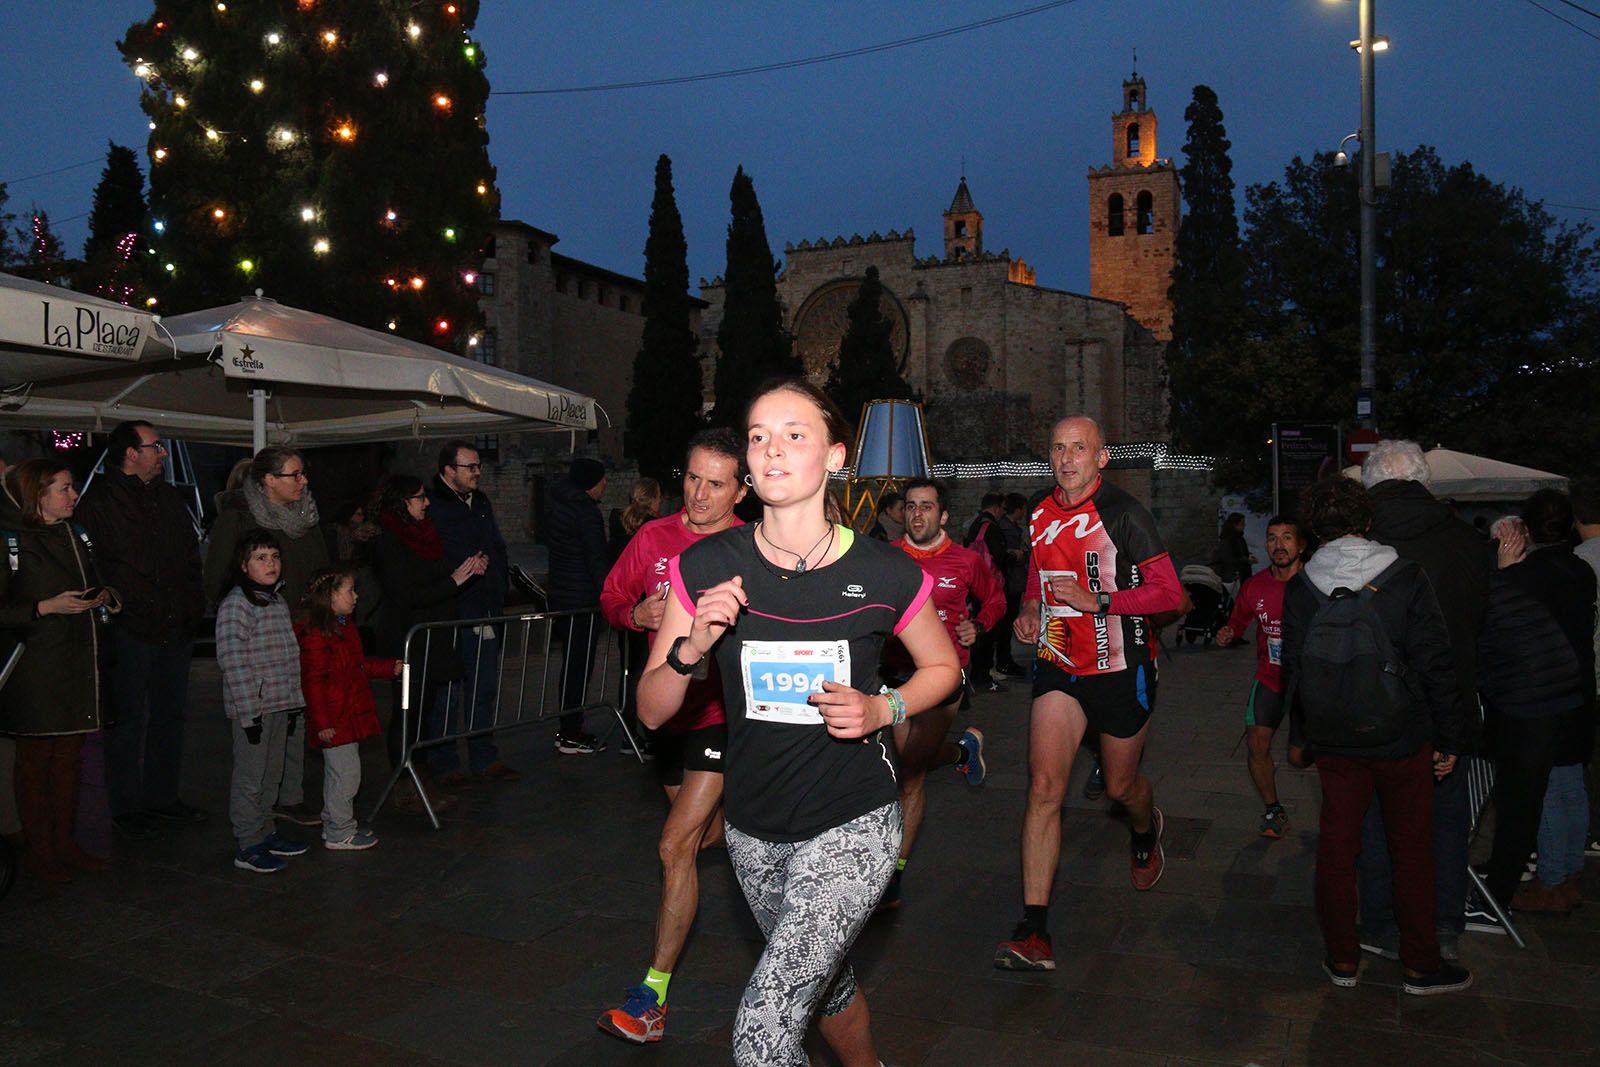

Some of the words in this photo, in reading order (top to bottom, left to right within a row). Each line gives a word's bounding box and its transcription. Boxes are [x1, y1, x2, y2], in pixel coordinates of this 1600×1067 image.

[41, 301, 72, 348] La
[75, 306, 140, 350] Placa
[232, 356, 264, 369] Estrella
[1085, 550, 1103, 593] 365
[1094, 614, 1111, 671] RUNNE
[759, 671, 826, 694] 1994
